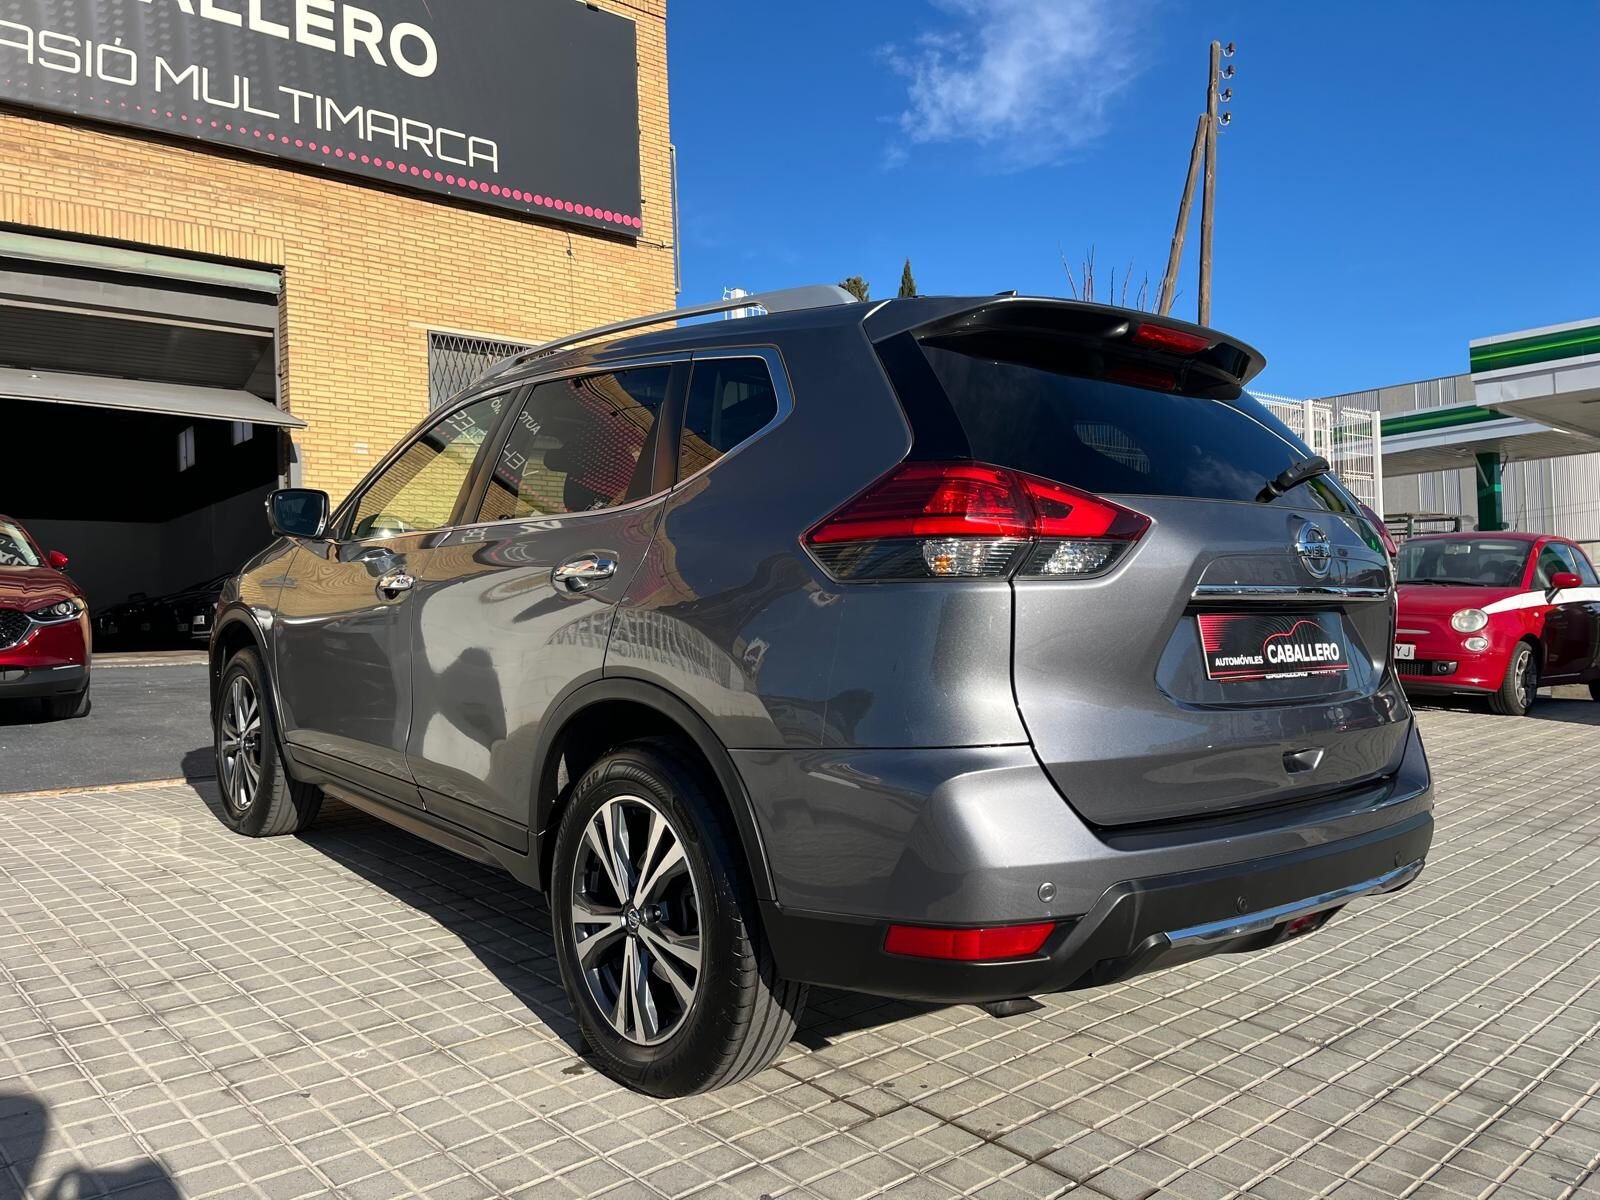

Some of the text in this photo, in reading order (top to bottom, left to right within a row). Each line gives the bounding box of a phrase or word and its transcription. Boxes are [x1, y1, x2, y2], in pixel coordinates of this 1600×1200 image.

[155, 56, 499, 173] MULTIMARCA
[1215, 643, 1340, 666] AUTOMÓVILES CABALLERO
